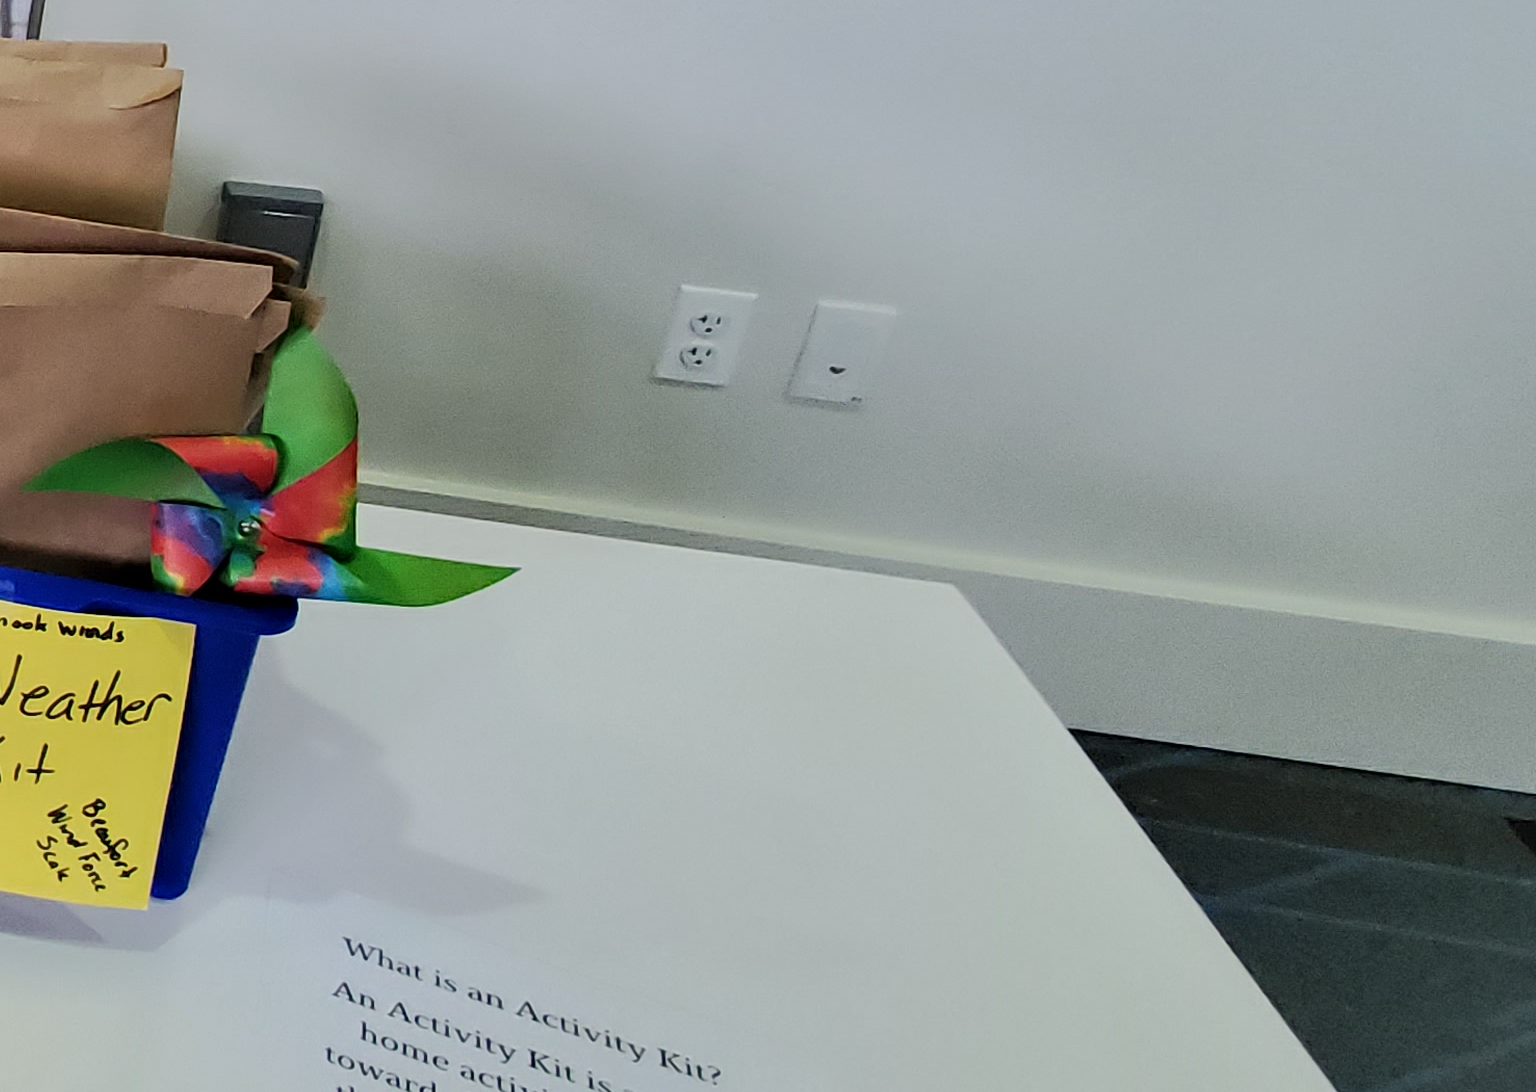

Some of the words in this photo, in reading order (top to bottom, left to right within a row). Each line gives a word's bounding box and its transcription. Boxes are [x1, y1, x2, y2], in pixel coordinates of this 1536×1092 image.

[332, 982, 377, 1011] An
[387, 1001, 517, 1064] Activity
[528, 1048, 576, 1083] Kit
[586, 1070, 612, 1092] is
[341, 936, 424, 981] What
[434, 969, 458, 993] is
[467, 986, 505, 1010] an
[515, 1001, 647, 1063] Activity
[658, 1047, 722, 1086] Kit?
[360, 1020, 450, 1071] home
[460, 1064, 550, 1092] acti
